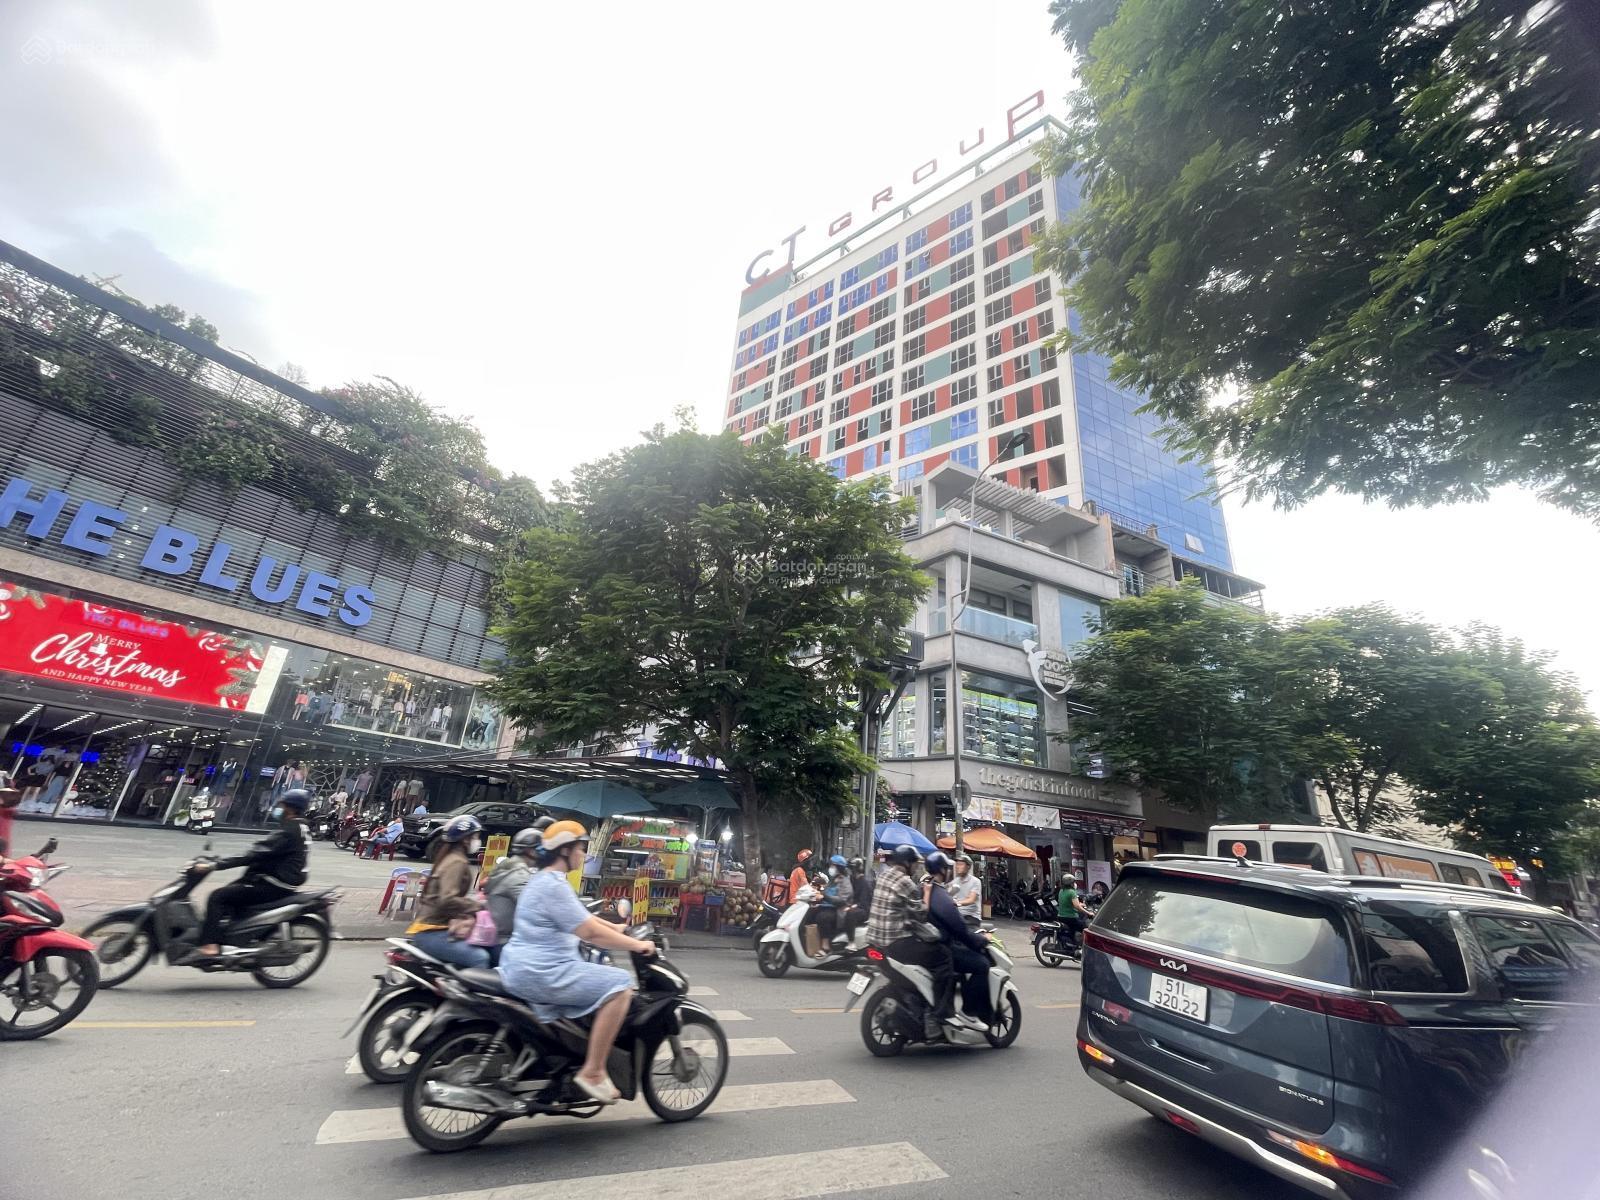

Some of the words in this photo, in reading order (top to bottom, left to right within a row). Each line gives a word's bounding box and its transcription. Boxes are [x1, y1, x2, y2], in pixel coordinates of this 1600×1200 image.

[745, 225, 806, 285] CT
[828, 89, 1045, 237] GROUP
[140, 524, 376, 627] BLUES
[96, 633, 142, 650] MERRY
[30, 632, 187, 688] Christmas
[41, 668, 66, 678] AND
[67, 671, 102, 685] HAPPY
[103, 678, 128, 689] NEW
[129, 683, 154, 693] YEAR
[1166, 978, 1189, 998] 51L
[1155, 990, 1199, 1017] 320.22
